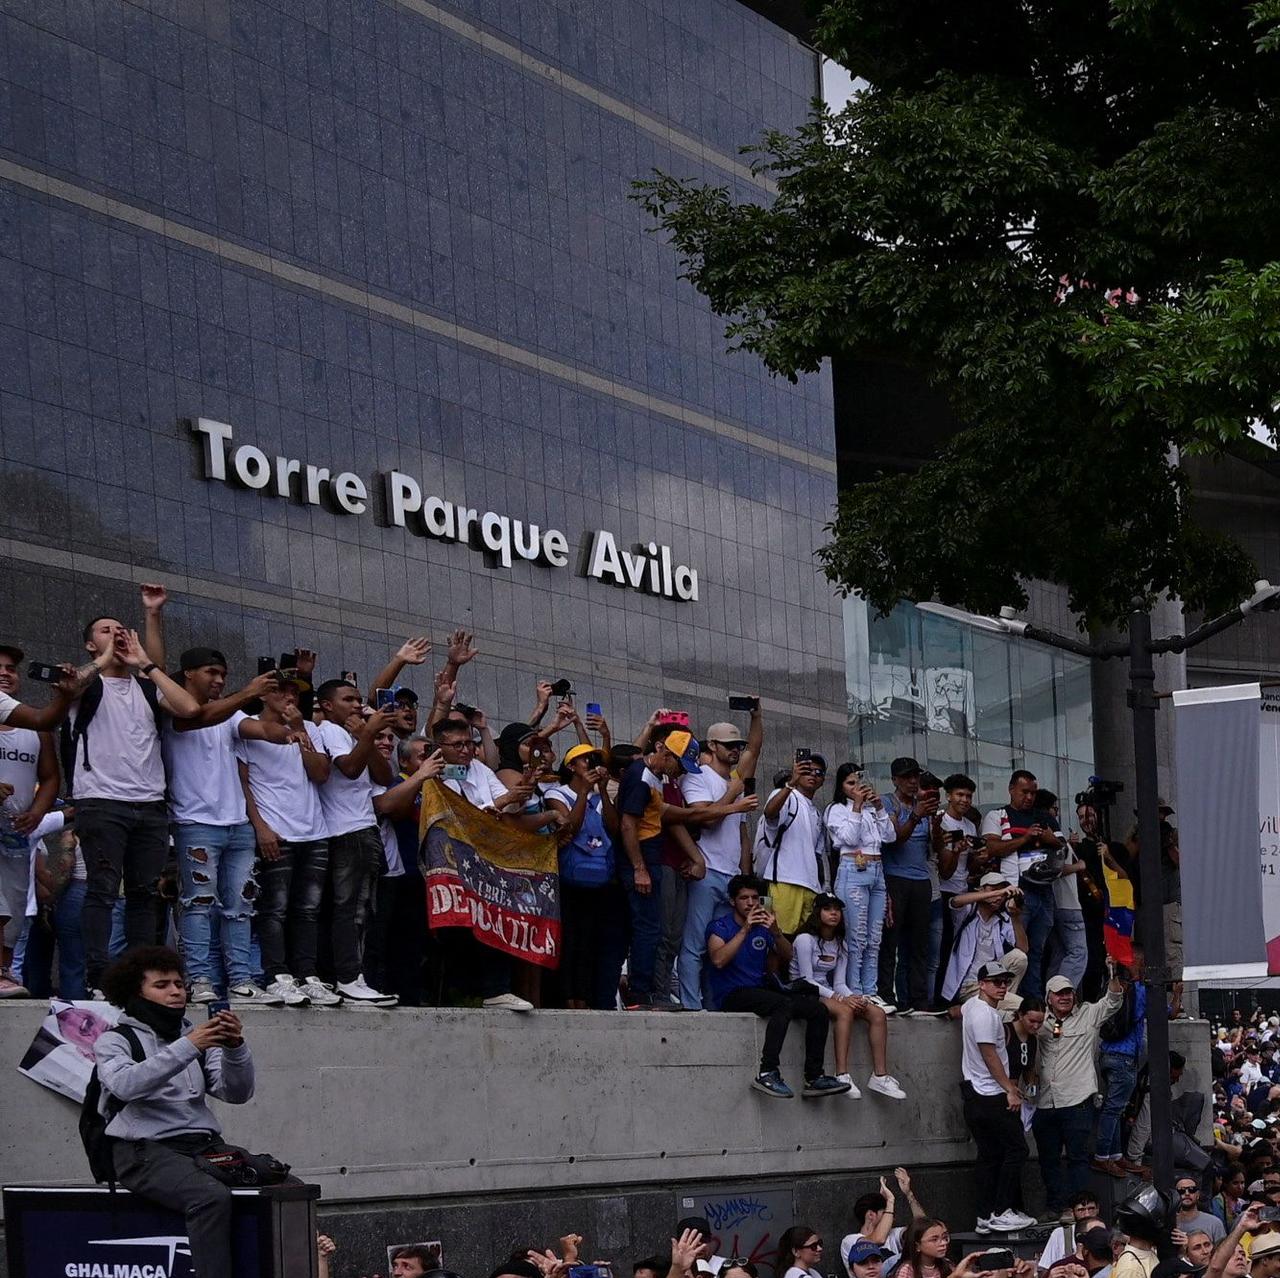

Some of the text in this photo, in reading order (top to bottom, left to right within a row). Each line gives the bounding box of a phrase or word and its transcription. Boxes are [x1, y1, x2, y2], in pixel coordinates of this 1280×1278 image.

[195, 417, 698, 601] Torre Parque Avila
[1261, 864, 1276, 875] #1
